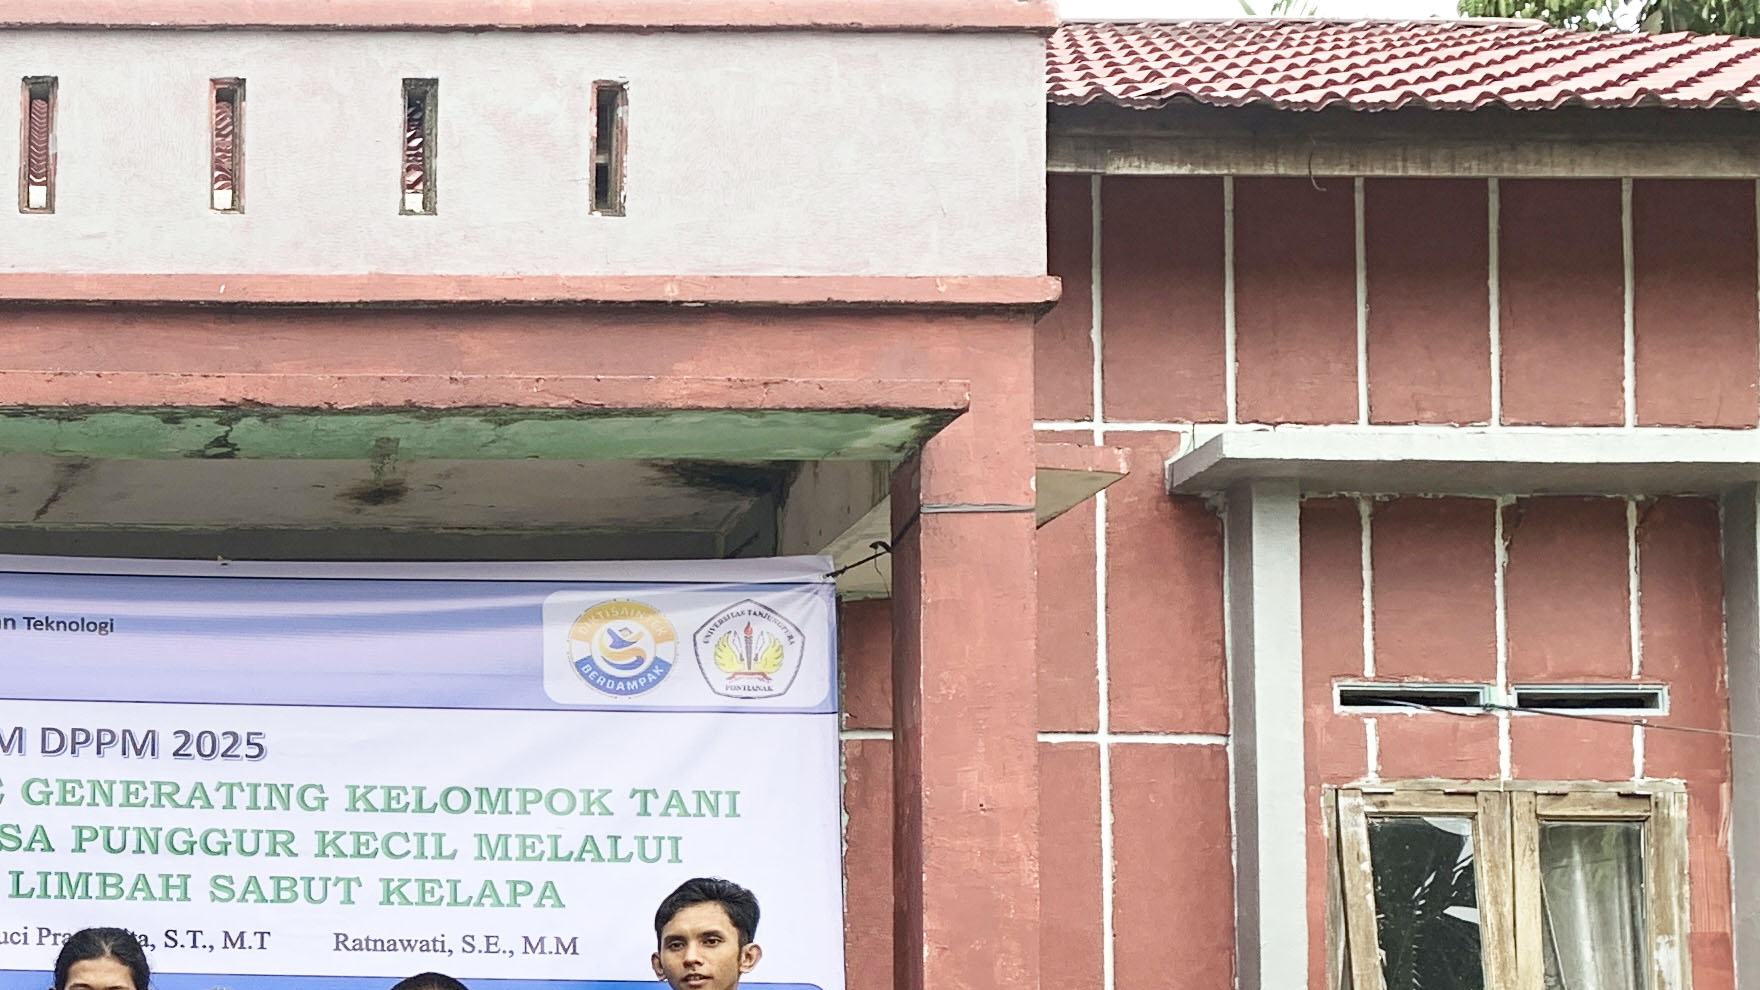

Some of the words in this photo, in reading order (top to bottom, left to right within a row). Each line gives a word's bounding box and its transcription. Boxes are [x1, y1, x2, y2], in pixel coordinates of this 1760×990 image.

[23, 616, 114, 636] Teknologi
[581, 663, 665, 691] BERDAMPAK
[40, 727, 159, 758] DPPM
[172, 729, 267, 761] 2025
[21, 777, 329, 812] GENERATING
[345, 784, 614, 816] KELOMPOK
[630, 787, 741, 818] TANI
[71, 825, 299, 857] PUNGGUR
[314, 829, 458, 861] KECIL
[474, 833, 683, 864] MELALUI
[8, 870, 192, 902] LIMBAH
[209, 874, 363, 905] SABUT
[378, 877, 566, 909] KELAPA
[163, 929, 214, 952] S.T.,
[222, 930, 272, 951] M.T
[333, 932, 453, 957] Ratnawati,
[462, 934, 515, 957] S.E.,
[522, 935, 580, 956] M.M
